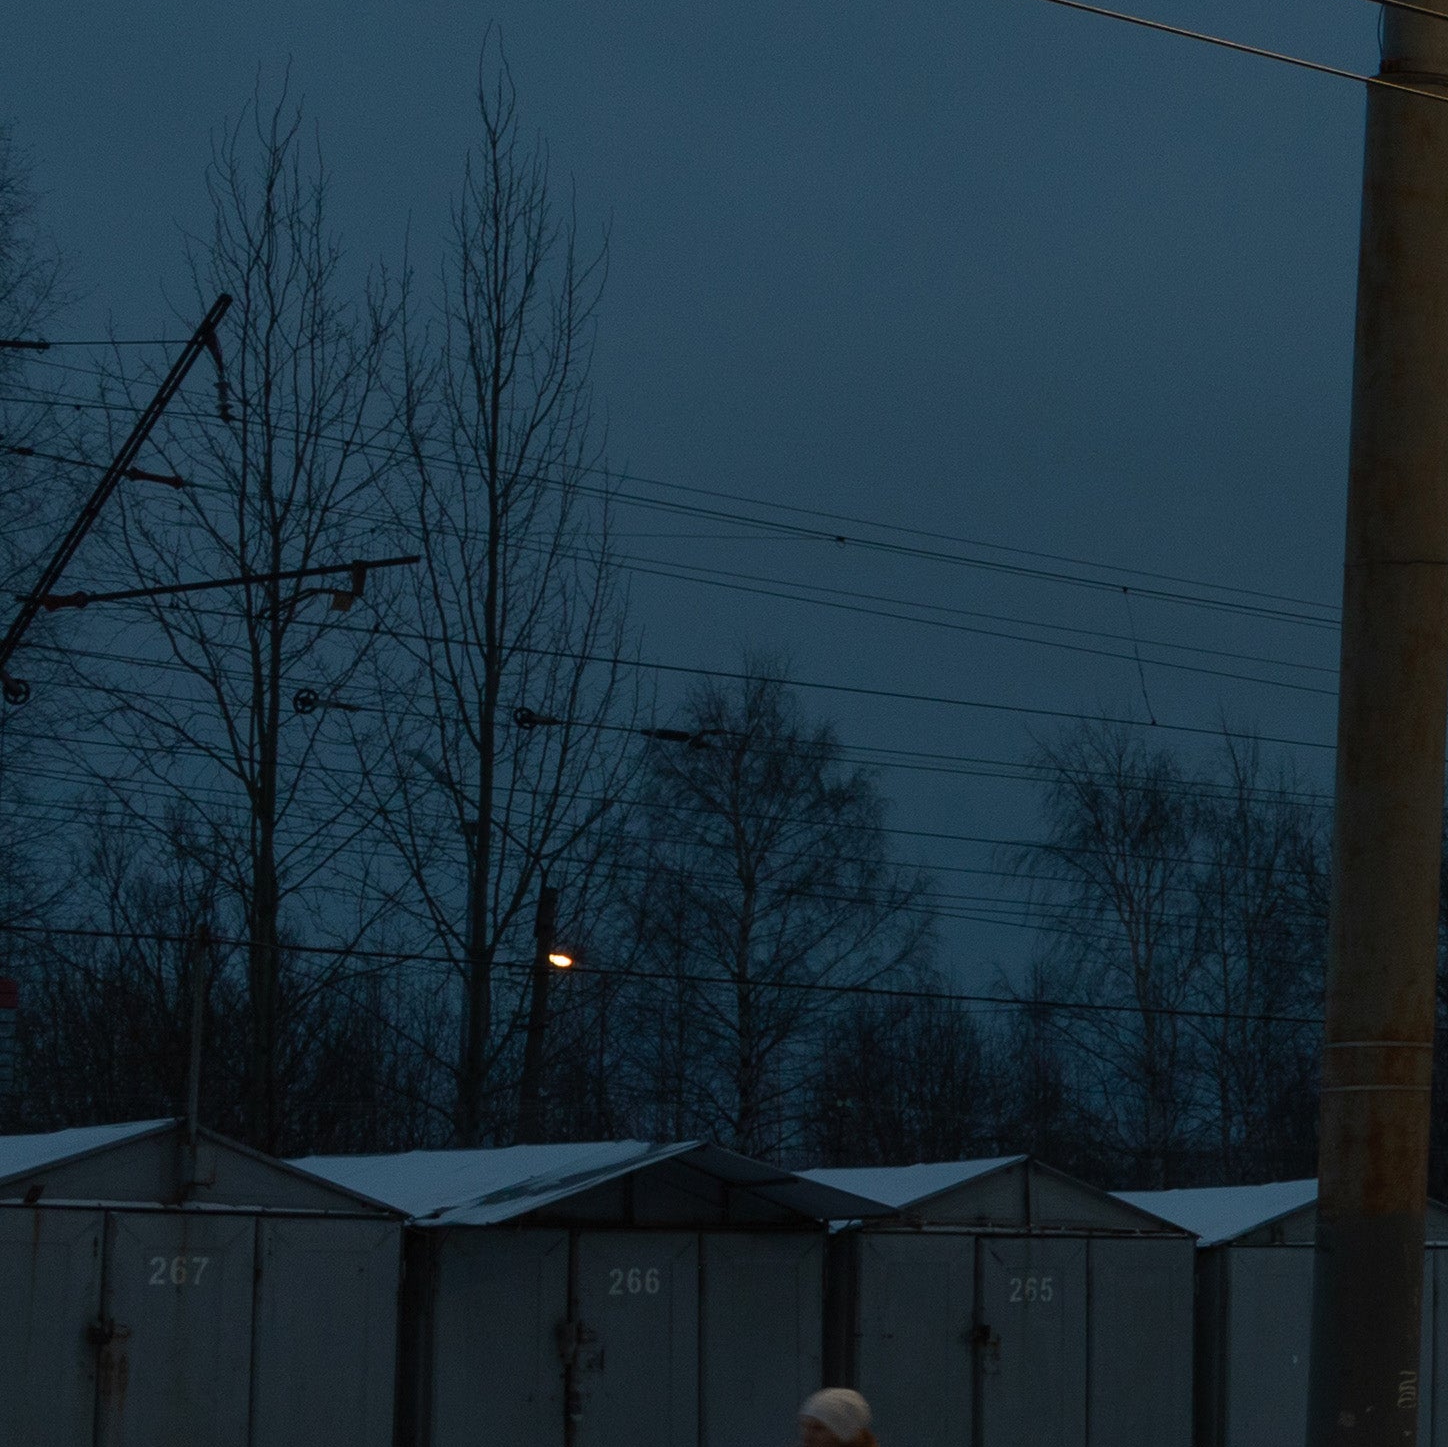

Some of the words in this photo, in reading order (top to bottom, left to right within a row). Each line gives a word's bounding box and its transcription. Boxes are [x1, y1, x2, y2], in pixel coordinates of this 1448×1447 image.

[149, 1256, 209, 1285] 267
[609, 1267, 661, 1295] 266
[1009, 1277, 1053, 1303] 265
